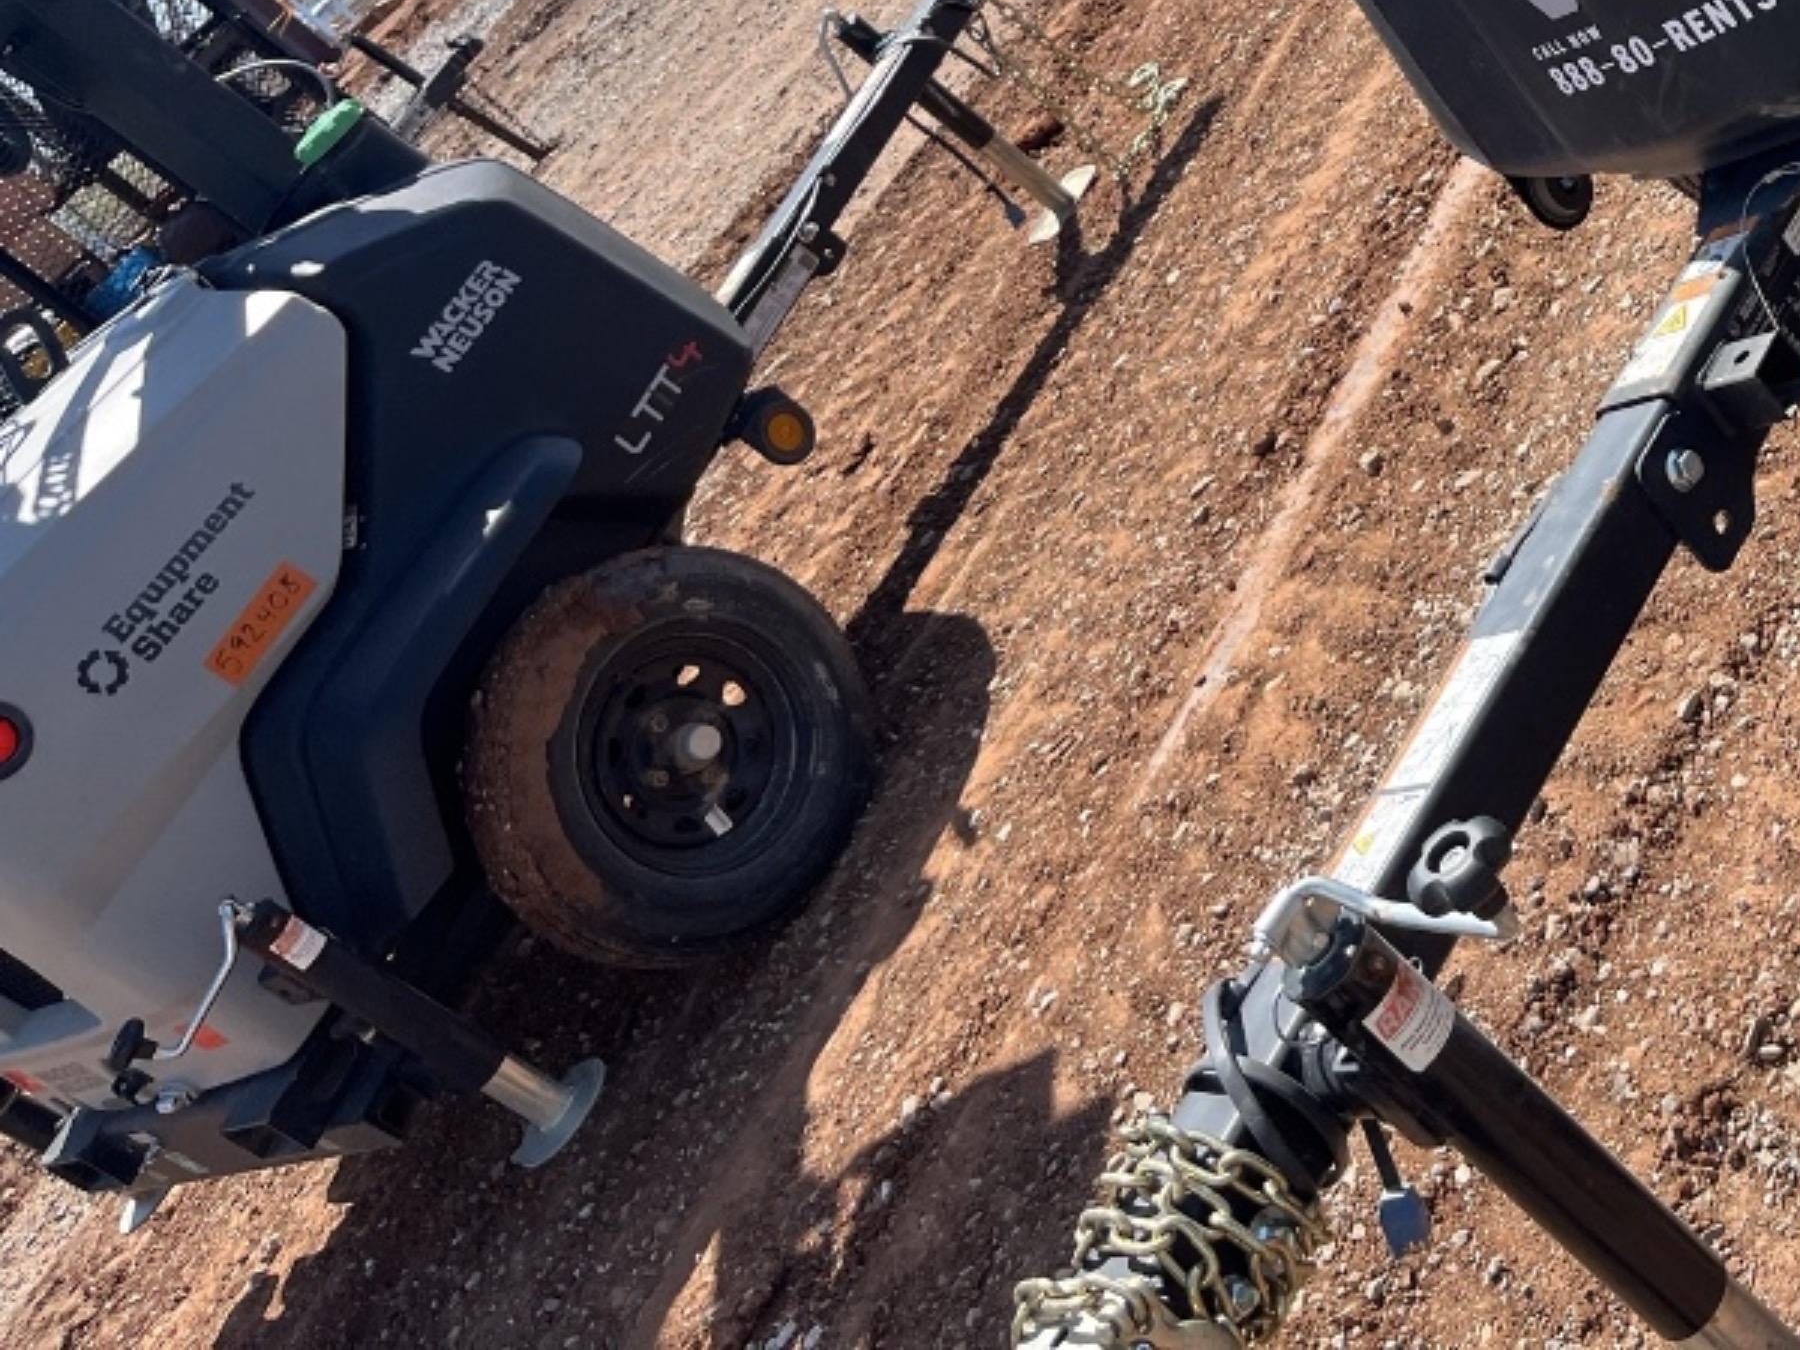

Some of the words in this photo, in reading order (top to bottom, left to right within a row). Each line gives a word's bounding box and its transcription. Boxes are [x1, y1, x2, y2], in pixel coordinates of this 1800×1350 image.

[1532, 39, 1567, 61] CALL
[1566, 24, 1602, 49] NOW
[410, 260, 501, 357] WACKER
[432, 268, 522, 372] NEUSON
[102, 482, 256, 645] Equipment
[131, 573, 220, 663] Share
